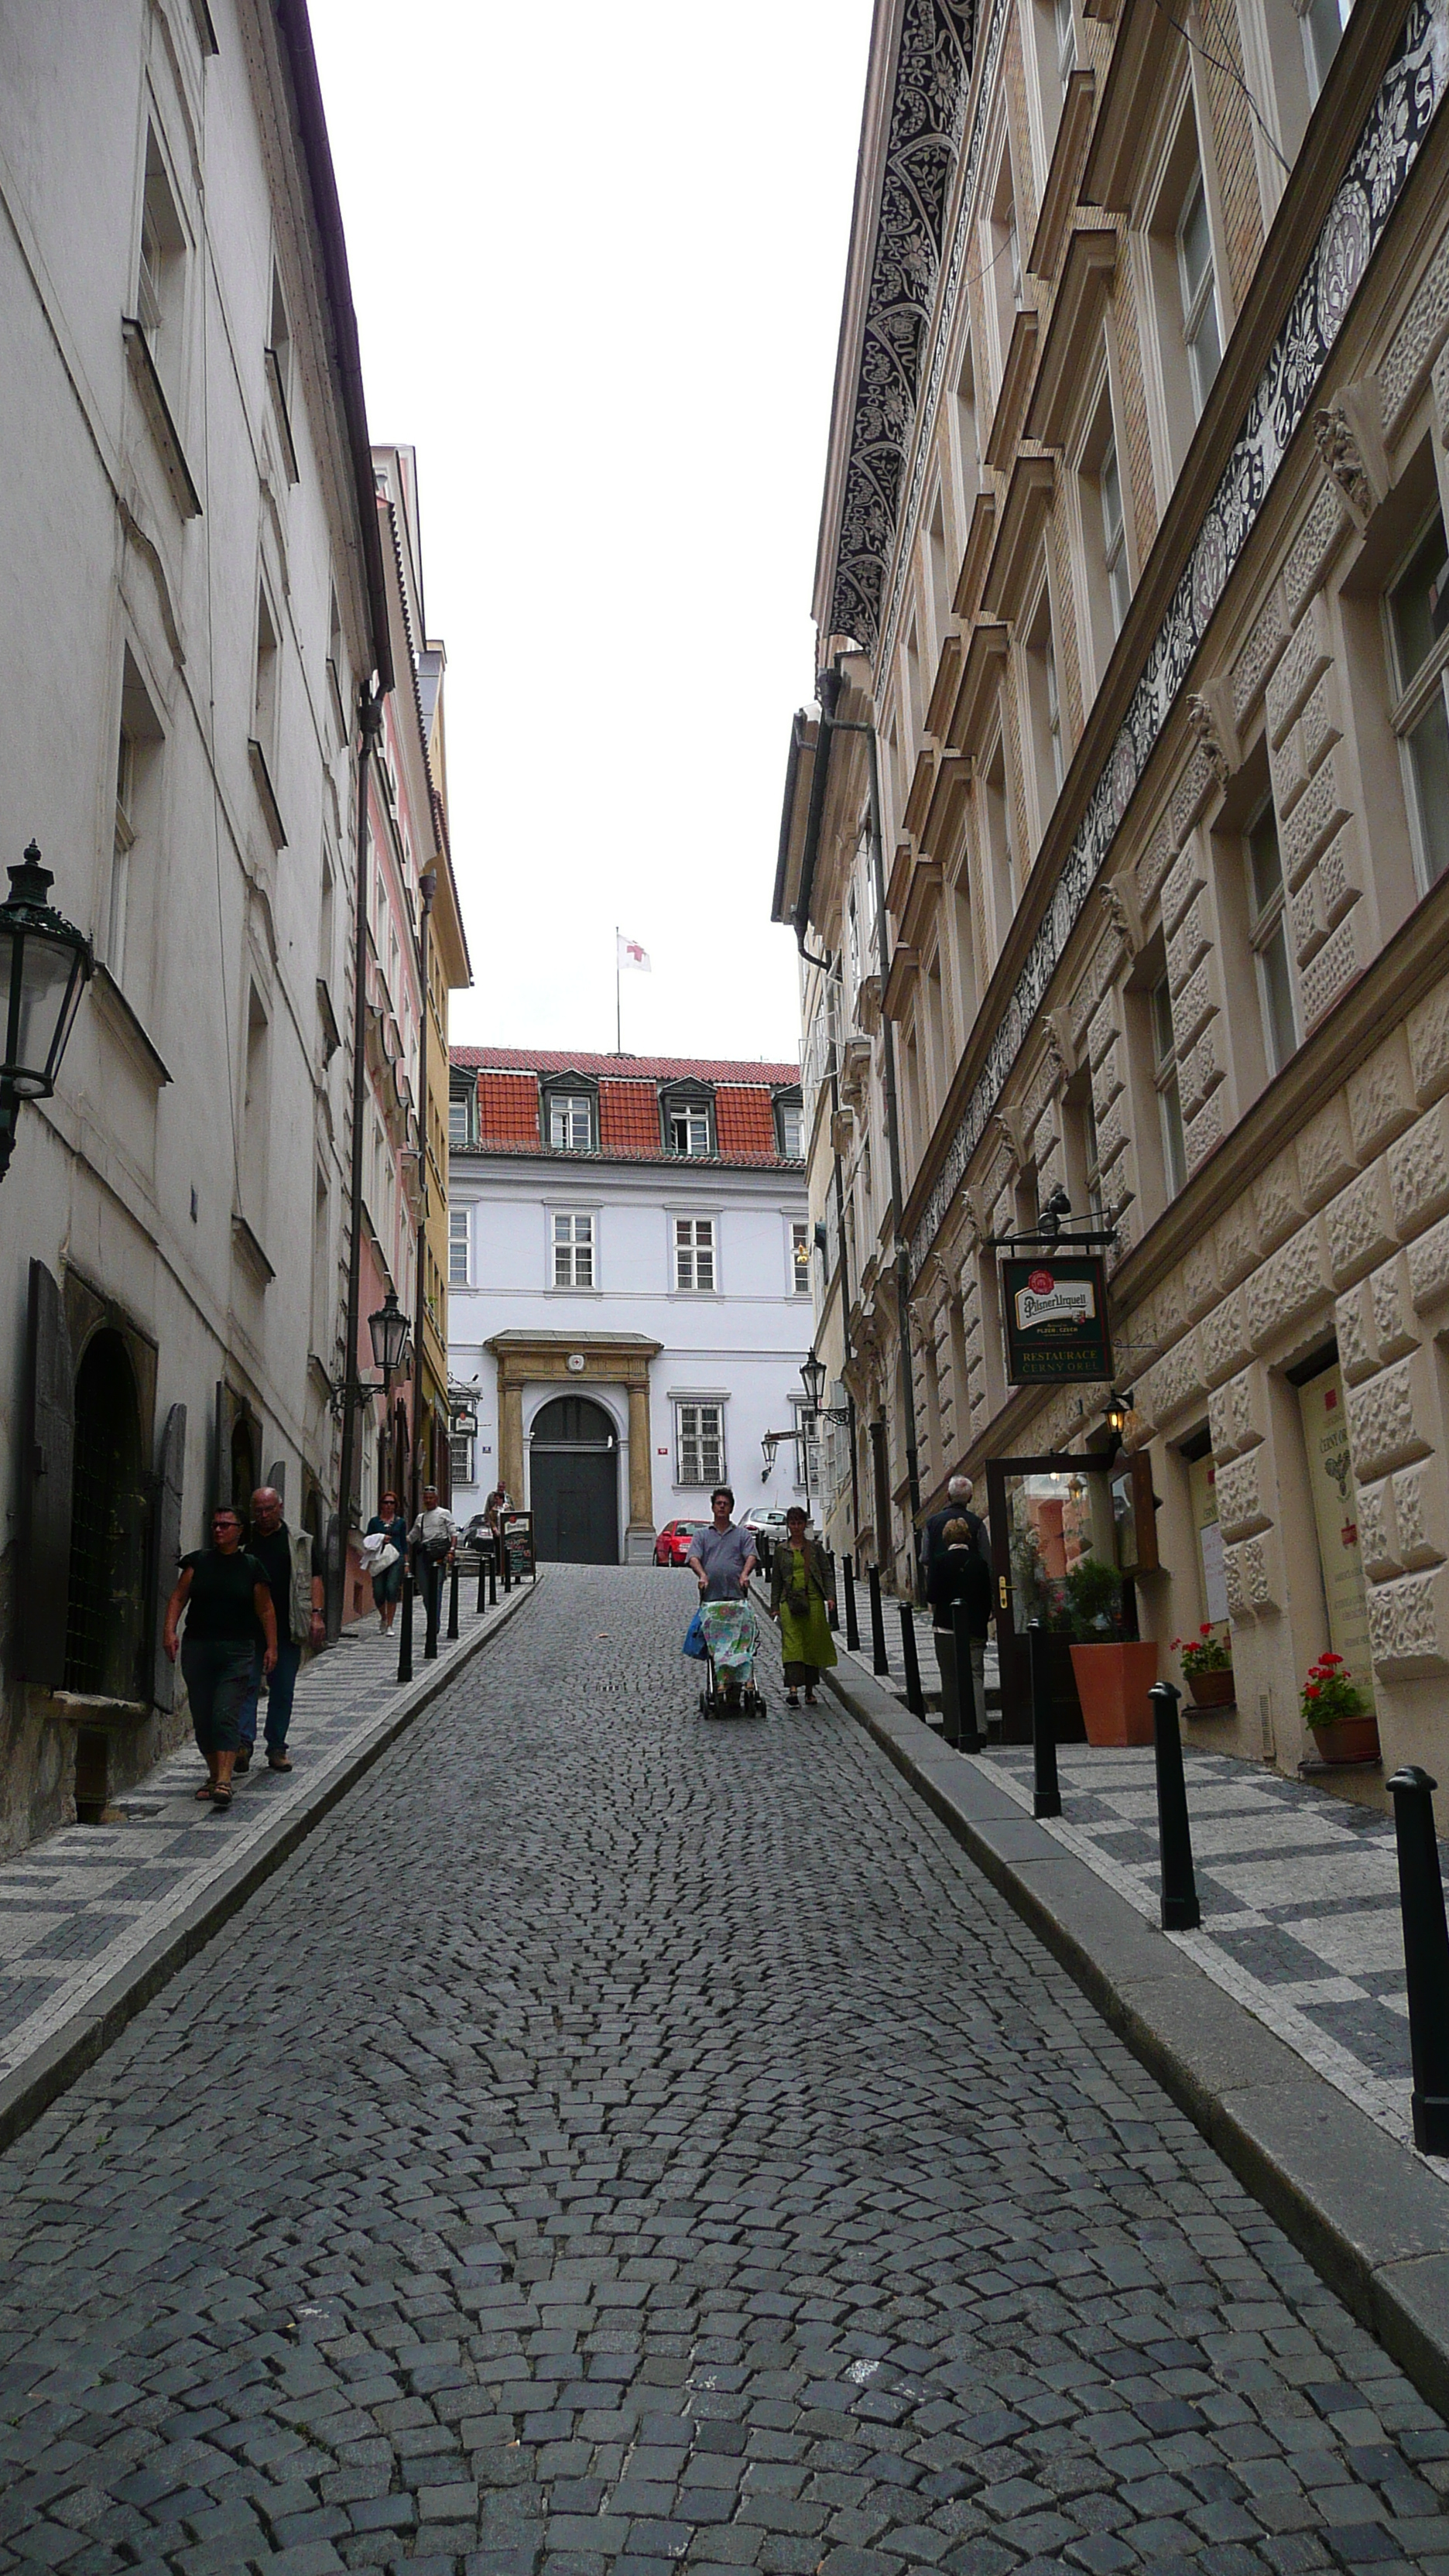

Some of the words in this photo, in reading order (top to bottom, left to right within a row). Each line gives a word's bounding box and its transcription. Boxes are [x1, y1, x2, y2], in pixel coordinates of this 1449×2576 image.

[1024, 1296, 1056, 1318] Pilsner
[1054, 1294, 1086, 1310] Urquell
[1023, 1350, 1098, 1362] RESTAURACE
[1023, 1363, 1064, 1372] ČERNÝ
[1067, 1362, 1099, 1371] OREL
